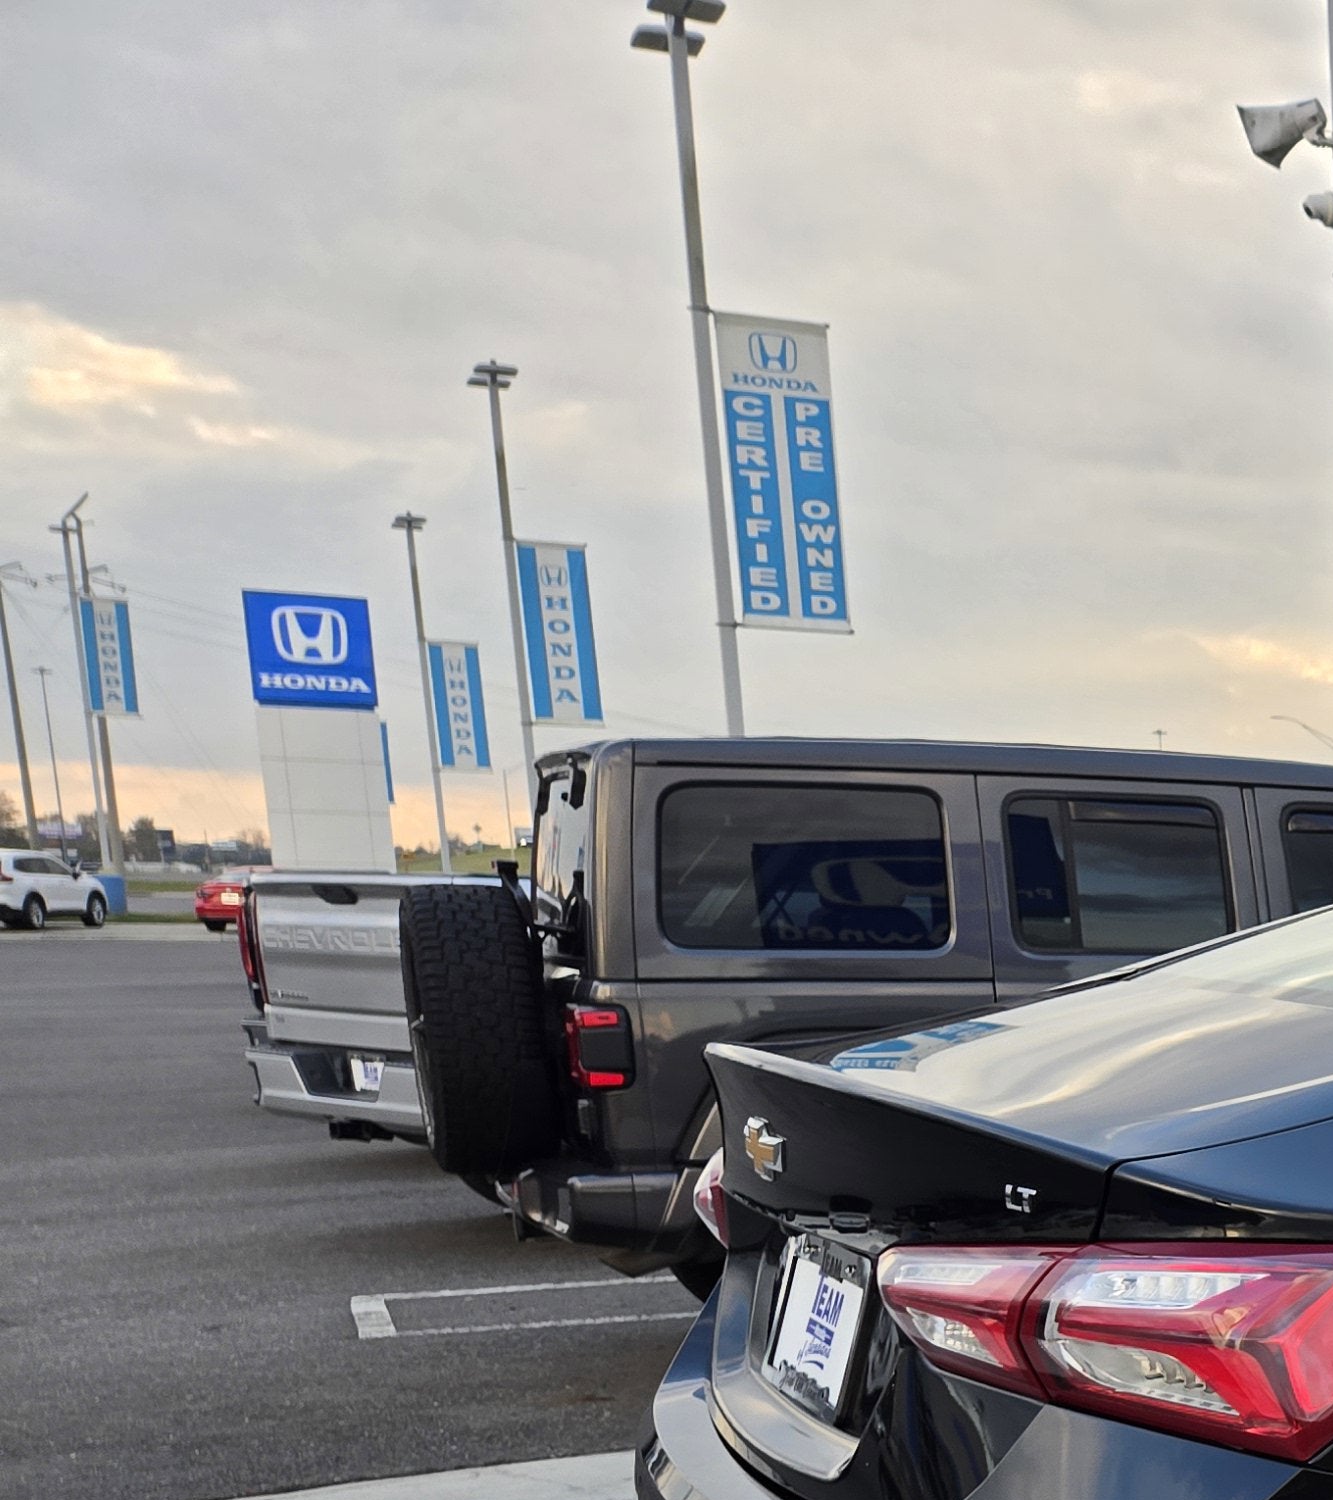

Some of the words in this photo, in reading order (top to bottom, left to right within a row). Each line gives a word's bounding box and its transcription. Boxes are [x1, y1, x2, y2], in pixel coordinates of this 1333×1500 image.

[731, 373, 819, 393] HONDA
[795, 401, 825, 473] PRE
[732, 395, 782, 613] CERTIFIED
[800, 500, 837, 616] OWNED
[100, 630, 122, 702] HONDA
[259, 672, 372, 694] HONDA
[545, 595, 580, 704] HONDA
[449, 679, 474, 756] HONDA
[1004, 1183, 1037, 1214] LT
[811, 1268, 845, 1328] TEAM
